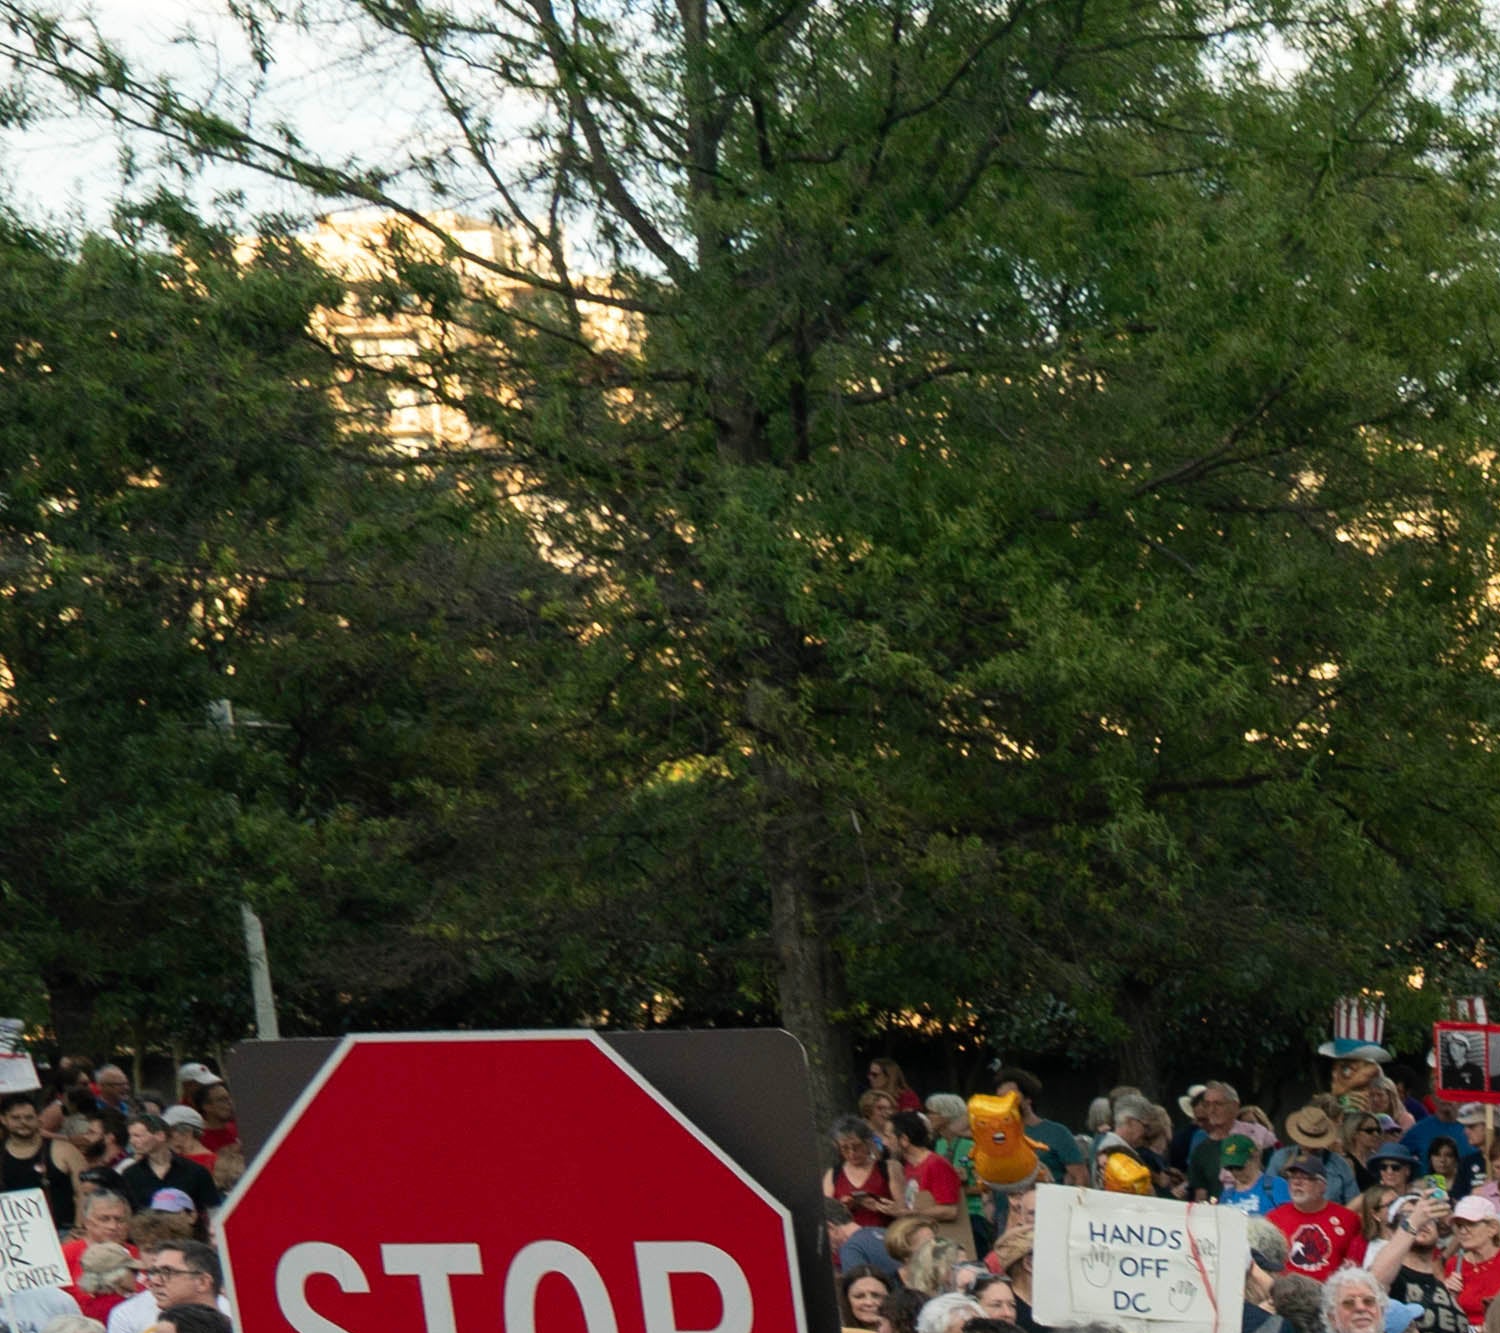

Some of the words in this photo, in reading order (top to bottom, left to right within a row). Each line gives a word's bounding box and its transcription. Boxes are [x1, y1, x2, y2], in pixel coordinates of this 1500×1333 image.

[1088, 1220, 1184, 1251] HANDS
[6, 1263, 66, 1292] CENTER
[1118, 1255, 1170, 1279] OFF
[1112, 1289, 1152, 1314] DC
